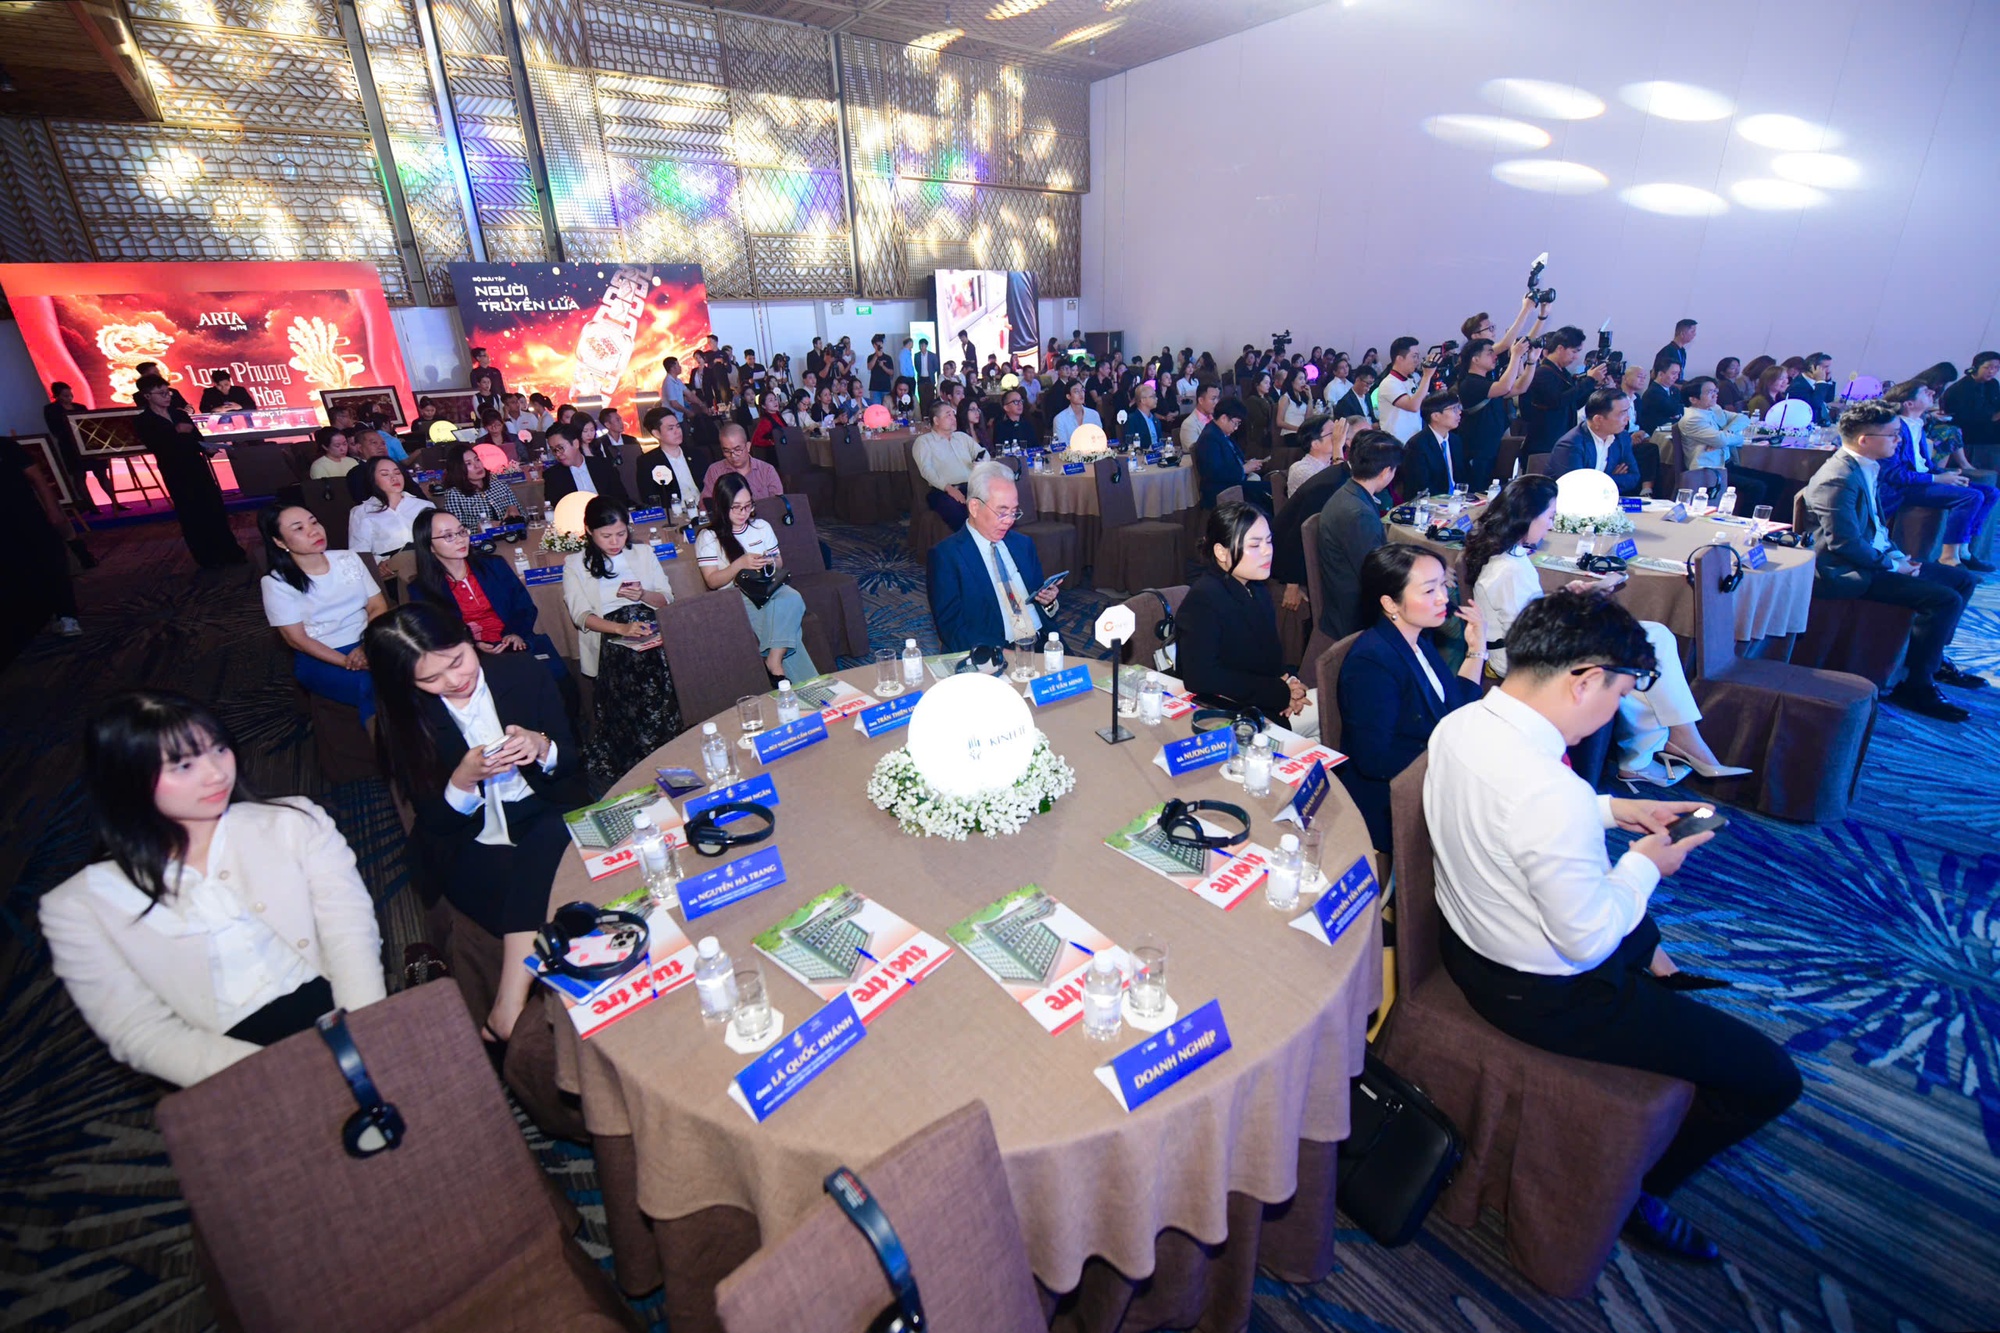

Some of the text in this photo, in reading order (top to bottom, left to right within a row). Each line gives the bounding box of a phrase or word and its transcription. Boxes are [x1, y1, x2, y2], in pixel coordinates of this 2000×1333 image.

[474, 282, 528, 297] NGƯỜI
[477, 297, 545, 312] TRUYỀN
[230, 361, 292, 385] Phụng
[249, 386, 286, 406] Hòa
[697, 880, 734, 901] NGUYỄN
[734, 876, 748, 887] HÀ
[748, 864, 777, 881] TRANG
[785, 1042, 819, 1075] QUỐC
[817, 1014, 854, 1050] KHÁNH
[1133, 1029, 1217, 1089] DOANH NGHIỆP
